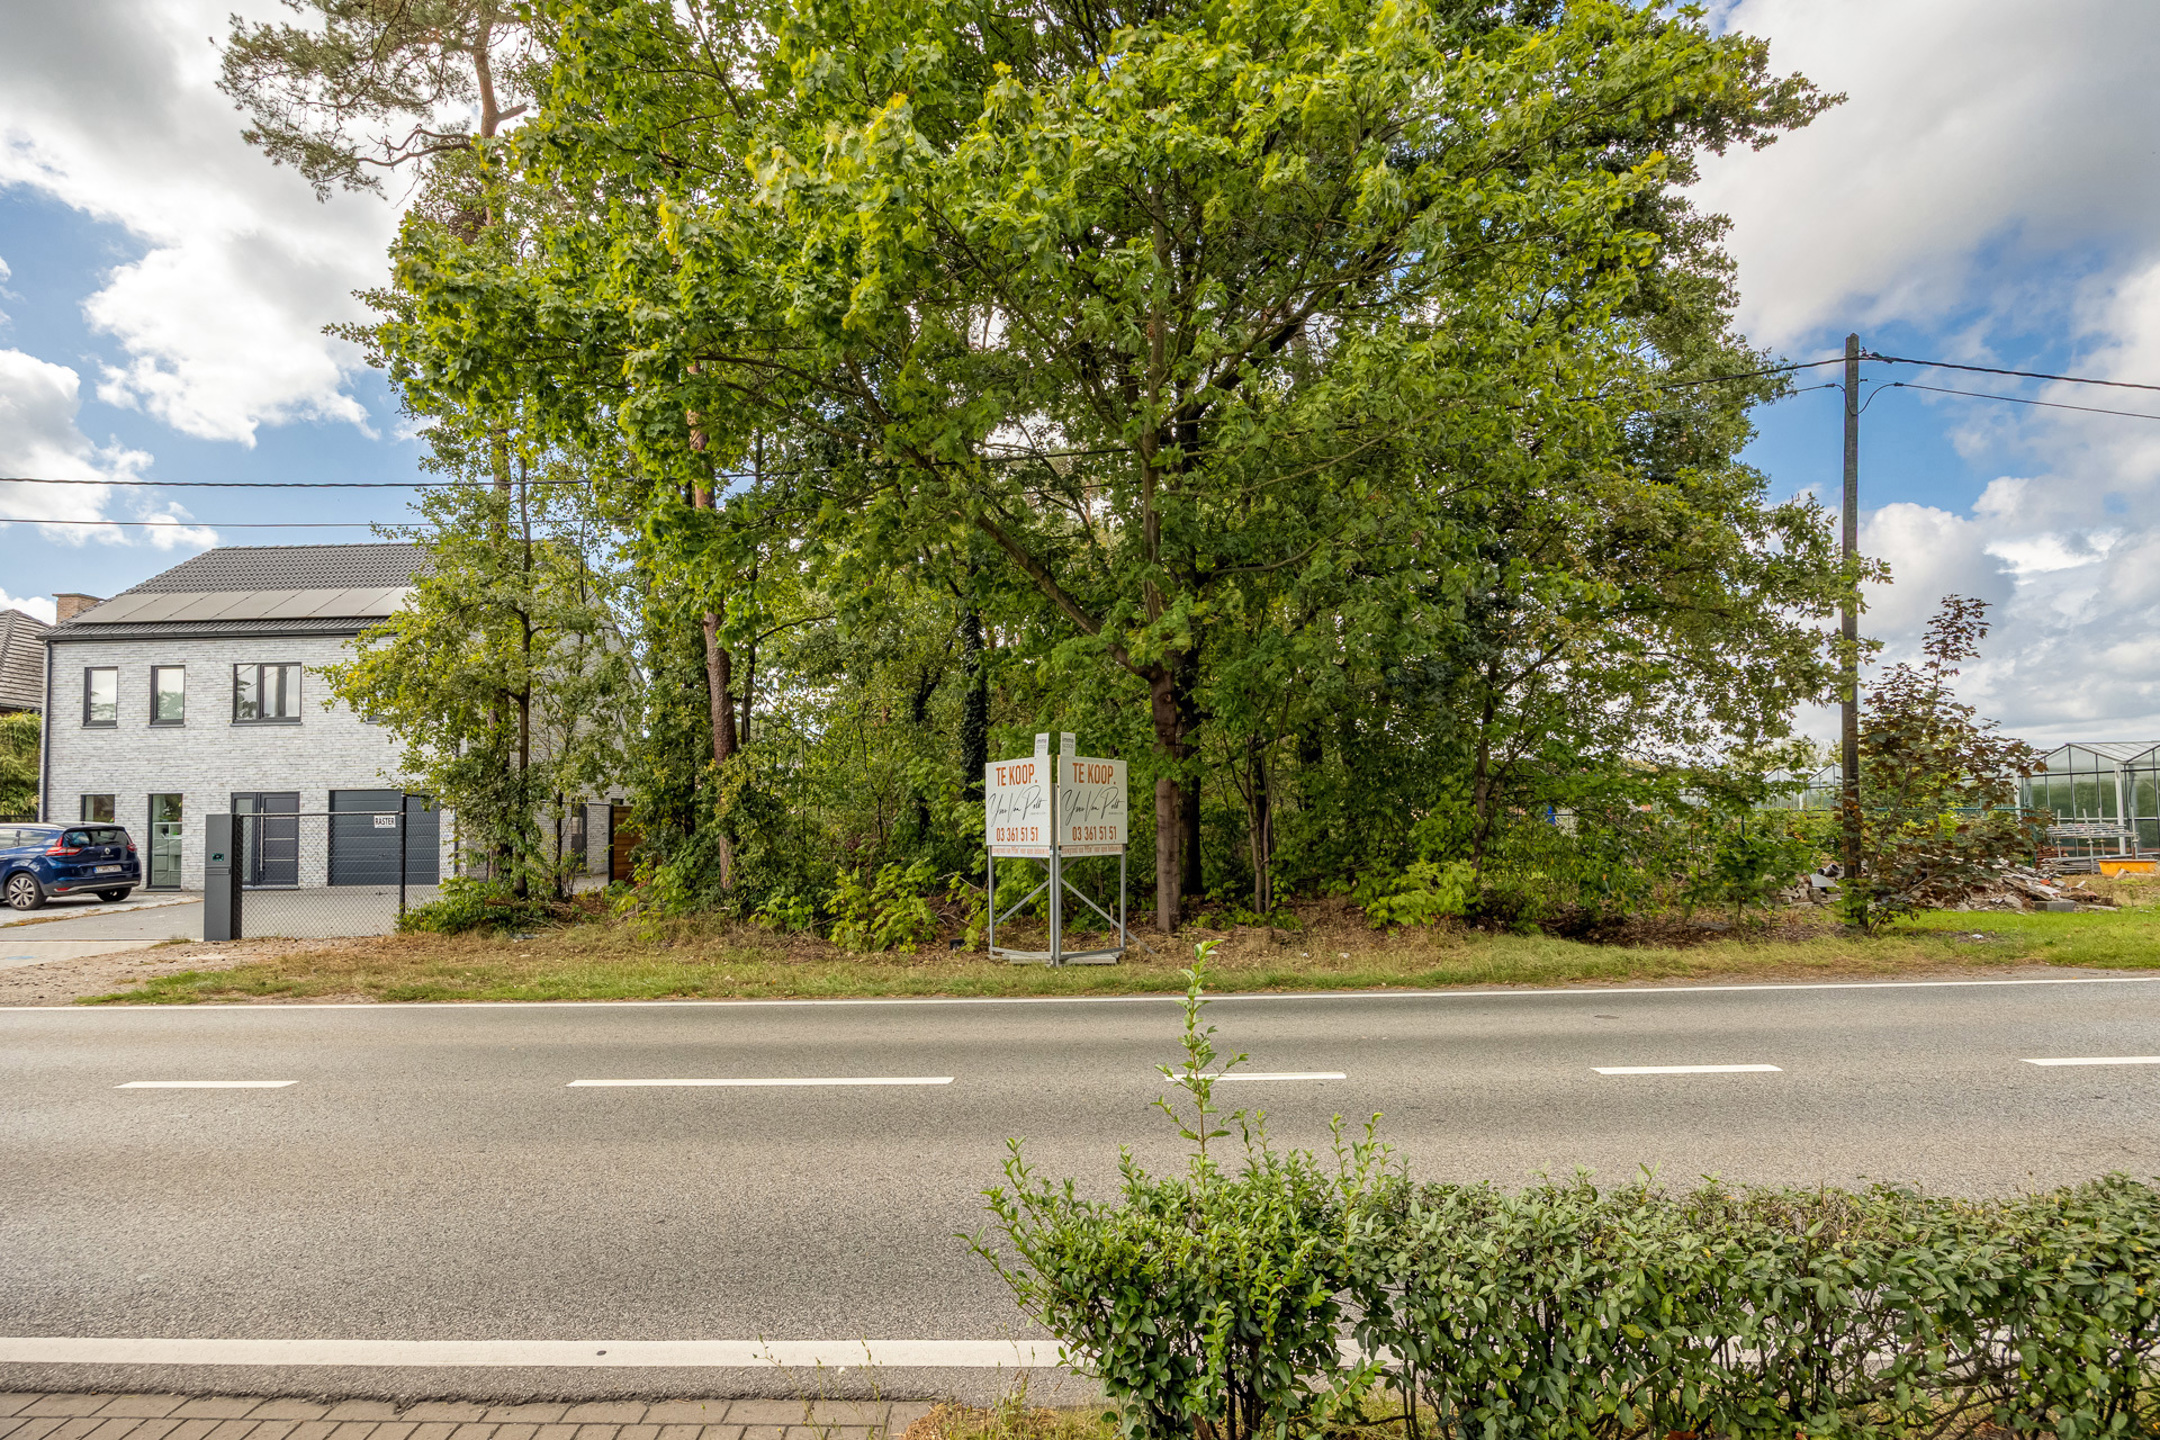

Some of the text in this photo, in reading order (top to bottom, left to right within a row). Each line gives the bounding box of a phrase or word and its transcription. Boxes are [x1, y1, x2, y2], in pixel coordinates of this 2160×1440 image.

[996, 763, 1038, 787] TE KOOP.
[1072, 762, 1116, 785] TE KOOP.
[375, 817, 394, 825] RASTER
[996, 826, 1038, 842] 03 361 51 51
[1072, 826, 1117, 841] 03 361 51 51
